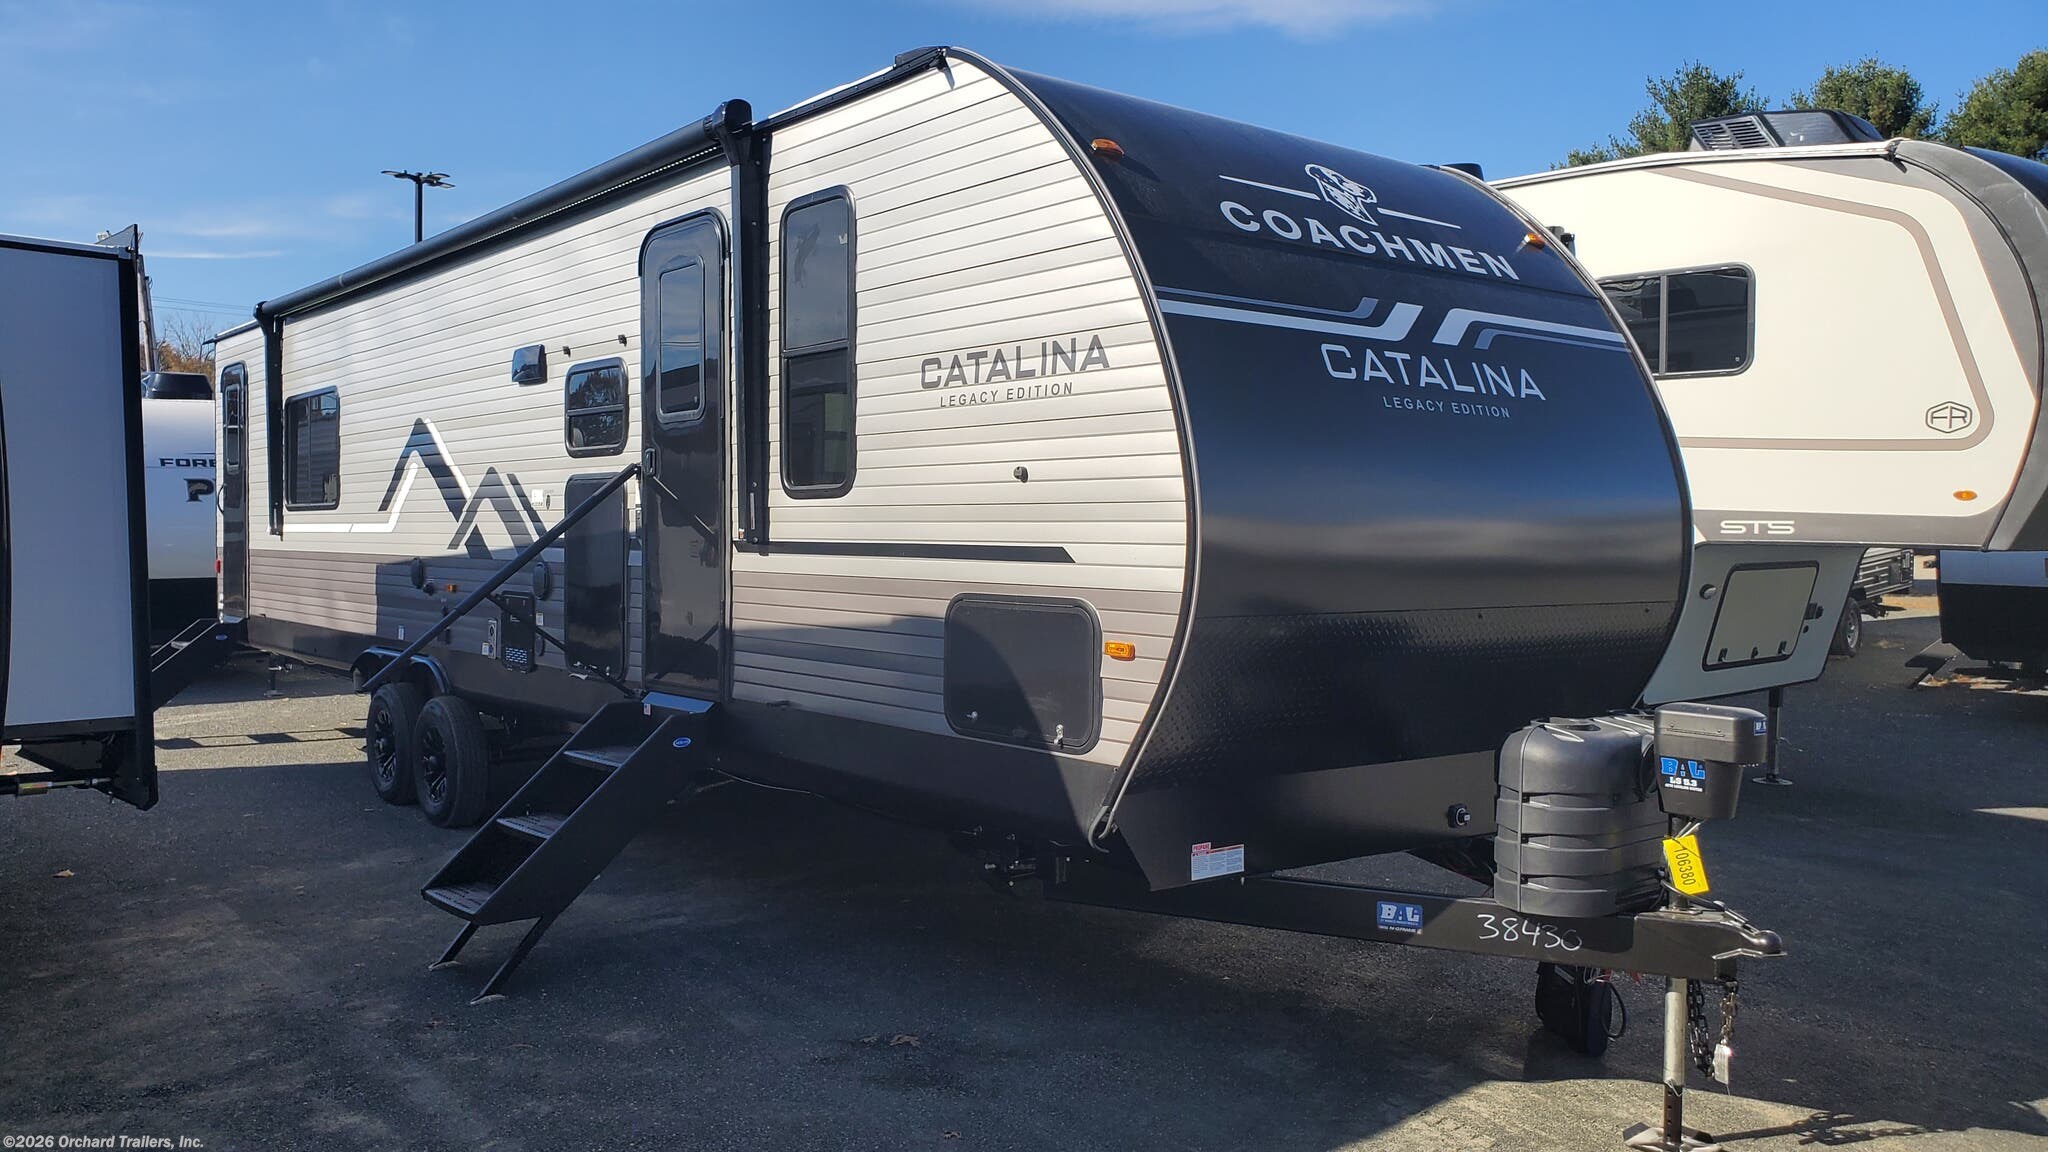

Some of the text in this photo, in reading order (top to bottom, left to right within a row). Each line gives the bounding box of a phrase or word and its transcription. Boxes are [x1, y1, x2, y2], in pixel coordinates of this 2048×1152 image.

[1219, 200, 1520, 281] COACHMEN
[920, 334, 1110, 390] CATALINA
[1320, 343, 1547, 401] CATALINA
[940, 382, 1073, 408] LEGACY EDITION
[1383, 396, 1511, 419] LEGACY EDITION
[1720, 520, 1795, 534] STS
[1673, 846, 1697, 886] 106380
[1476, 913, 1583, 951] 38430
